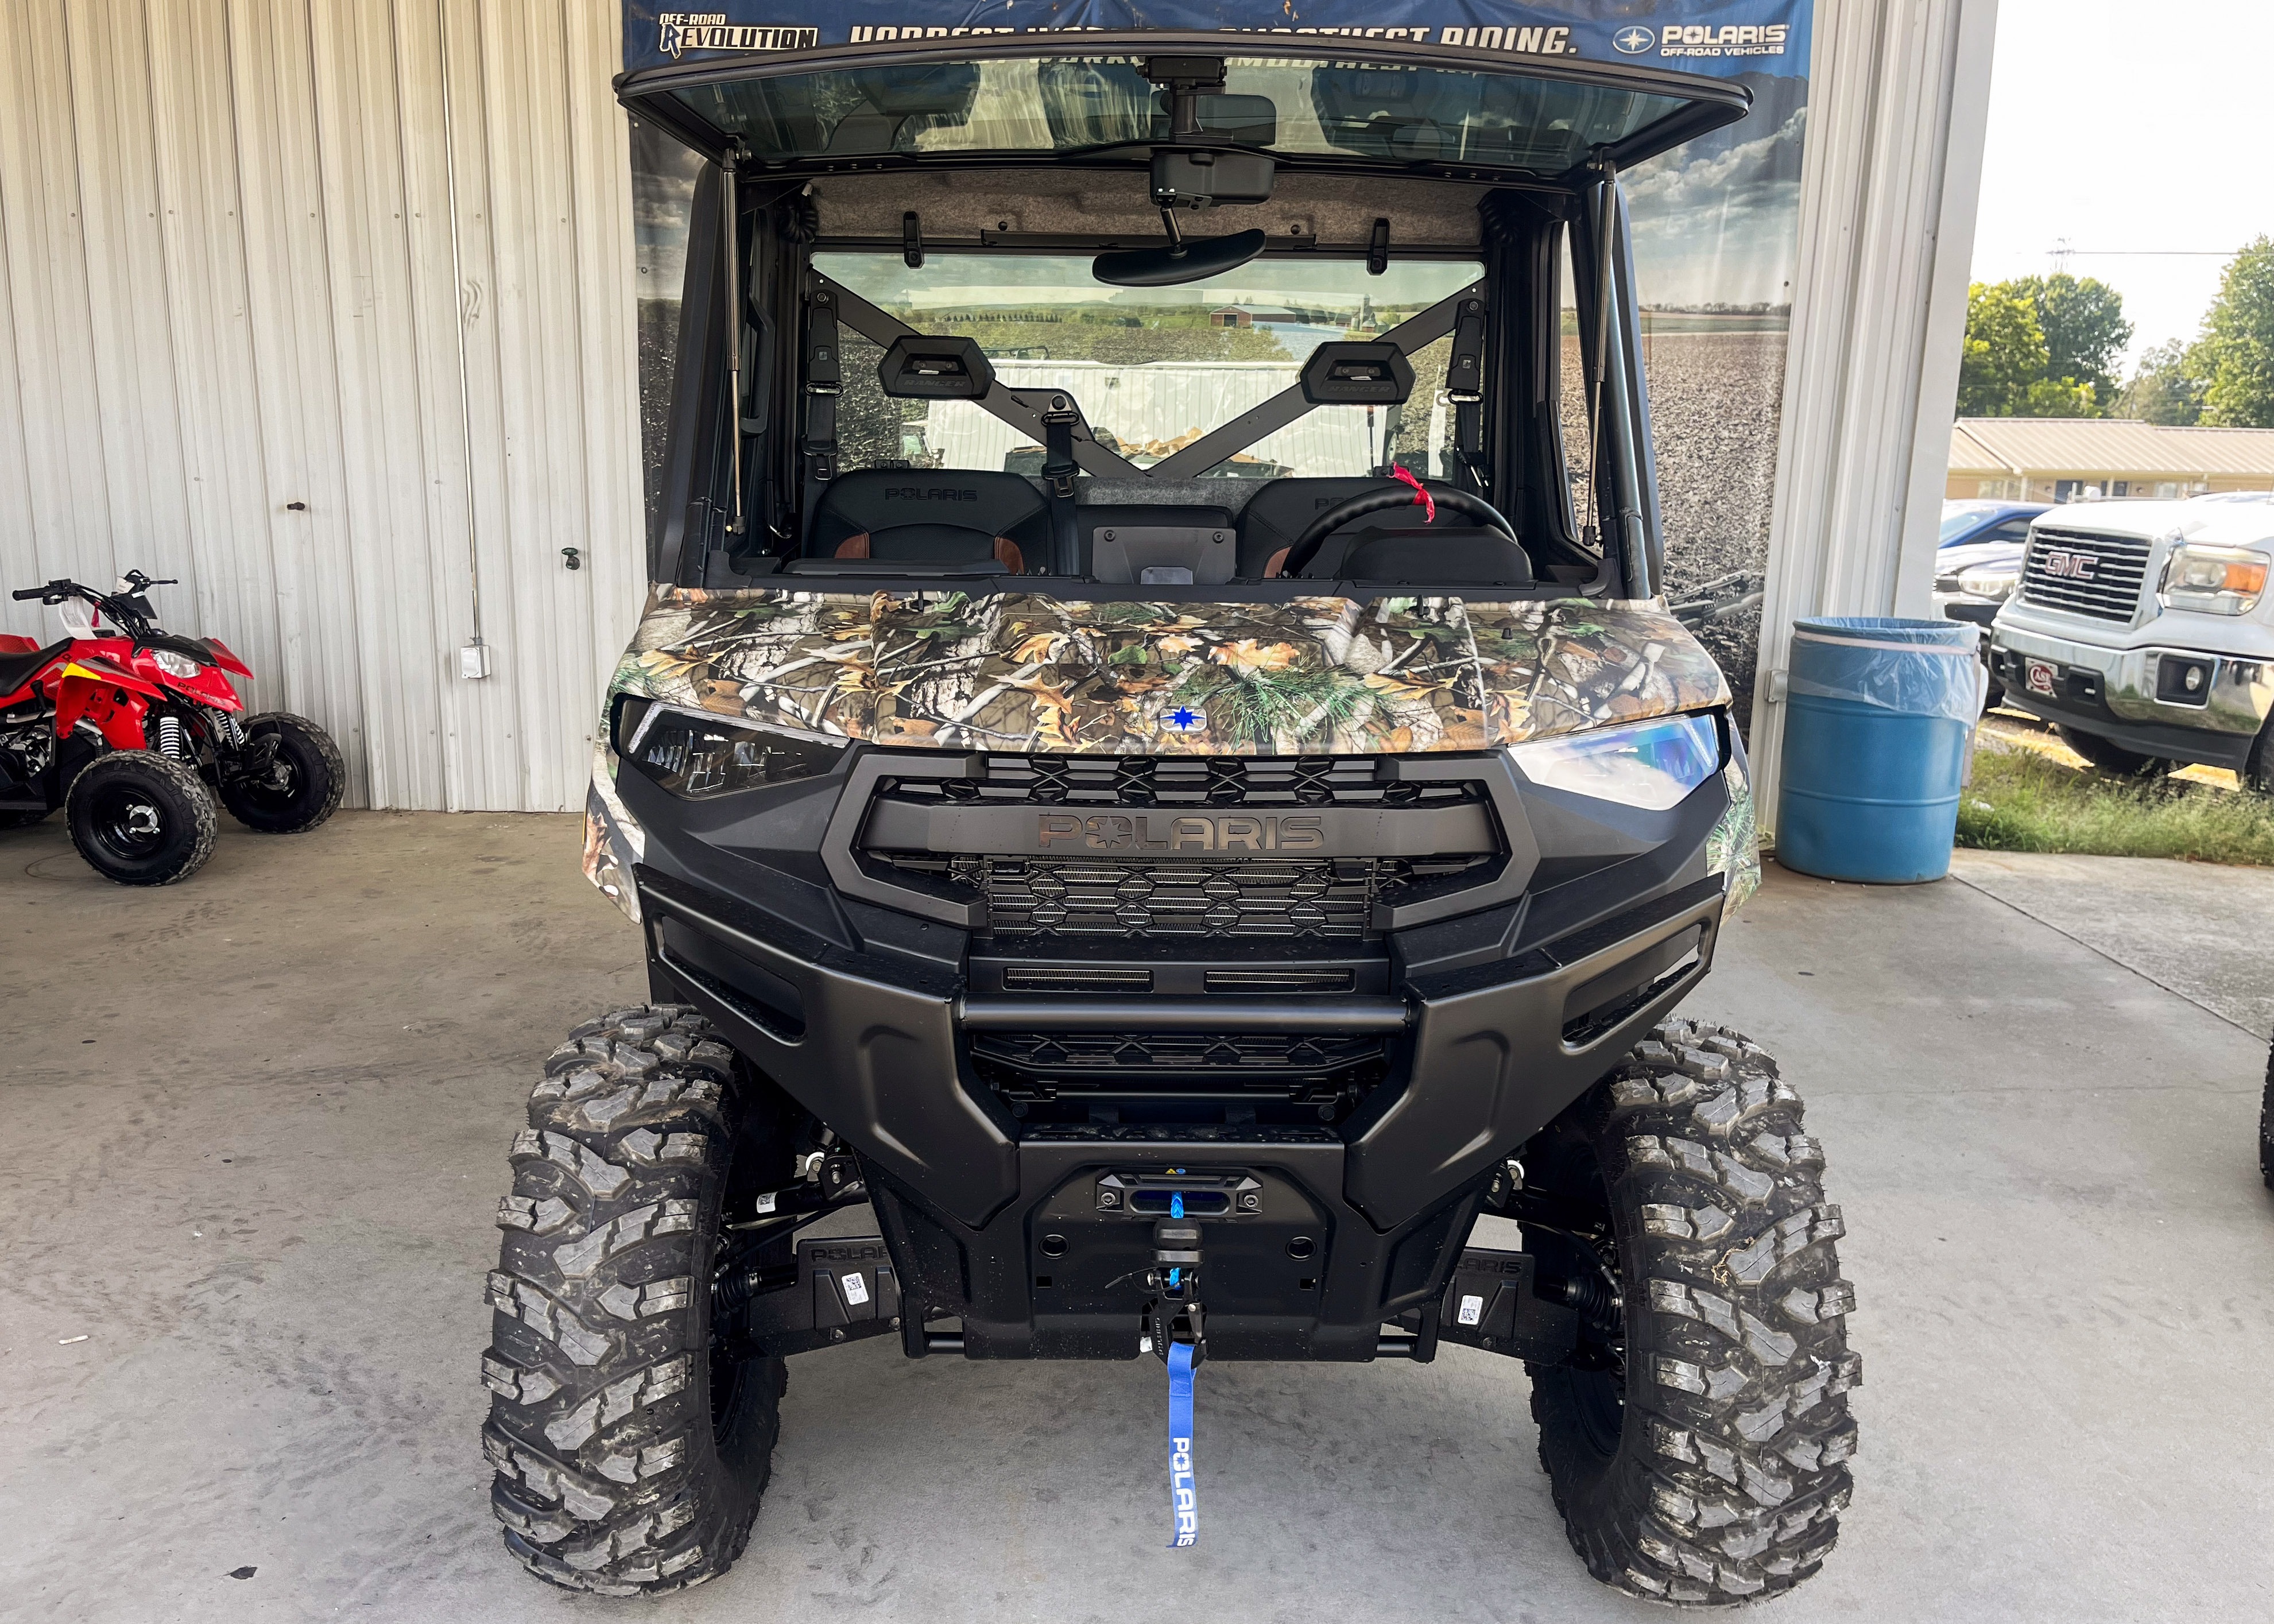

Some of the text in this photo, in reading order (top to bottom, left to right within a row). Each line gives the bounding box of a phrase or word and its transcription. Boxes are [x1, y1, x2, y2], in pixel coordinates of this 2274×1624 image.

[660, 14, 726, 25] OFF-ROAD
[660, 22, 818, 59] REVOLUTION
[1661, 25, 1787, 44] POLARIS
[1661, 46, 1785, 56] OFF-ROAD VEHICLES
[885, 488, 978, 501] POLARIS
[2045, 551, 2099, 580] GMC
[1039, 814, 1324, 851] POLARIS
[811, 1246, 889, 1262] POLAR
[1456, 1257, 1522, 1273] ARIS
[1173, 1437, 1196, 1547] POLARIS
